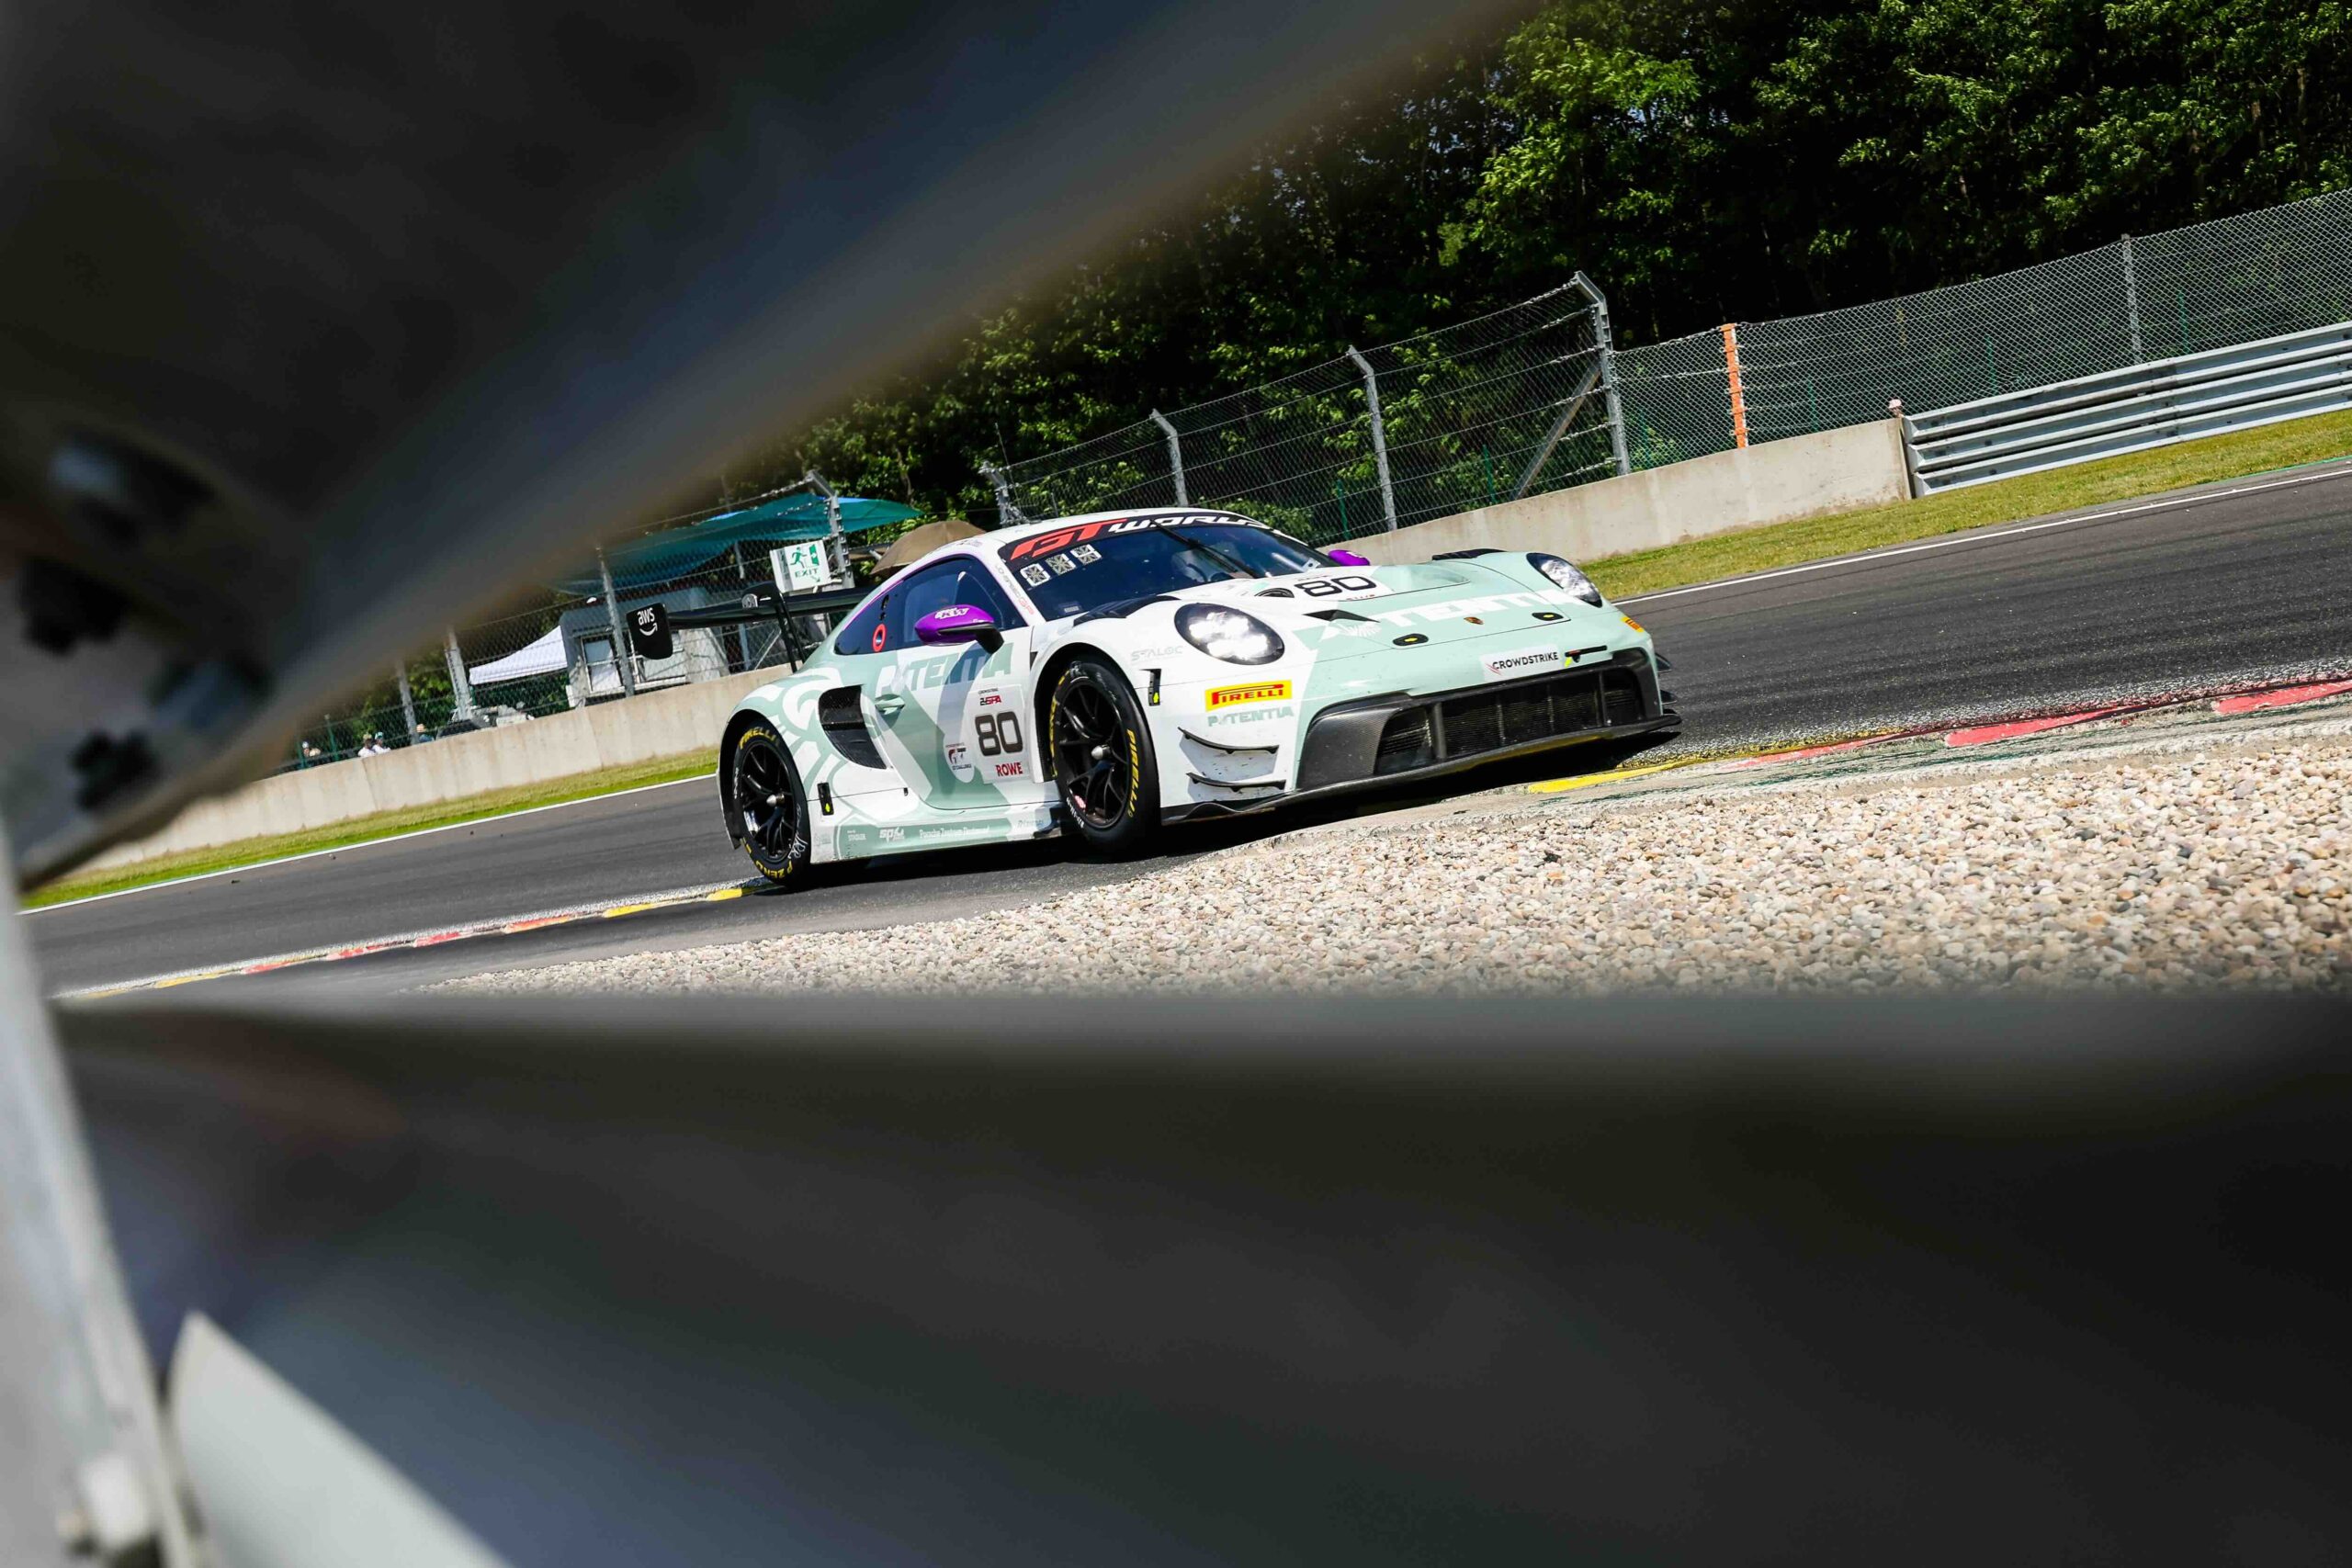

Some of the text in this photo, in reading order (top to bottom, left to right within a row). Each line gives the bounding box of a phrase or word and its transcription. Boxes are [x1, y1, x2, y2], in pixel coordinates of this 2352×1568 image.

[795, 569, 818, 578] EXIT
[1294, 576, 1377, 597] 80
[638, 607, 655, 626] aws
[875, 642, 1014, 698] PTENTIA
[1492, 651, 1558, 670] CROWDSTRIKE
[1211, 683, 1284, 705] PIRELLI
[739, 727, 780, 750] PIRELLI
[975, 711, 1023, 756] 80
[995, 761, 1023, 777] ROWE
[1127, 728, 1139, 814] PIRELLI
[755, 860, 786, 879] ZERO
